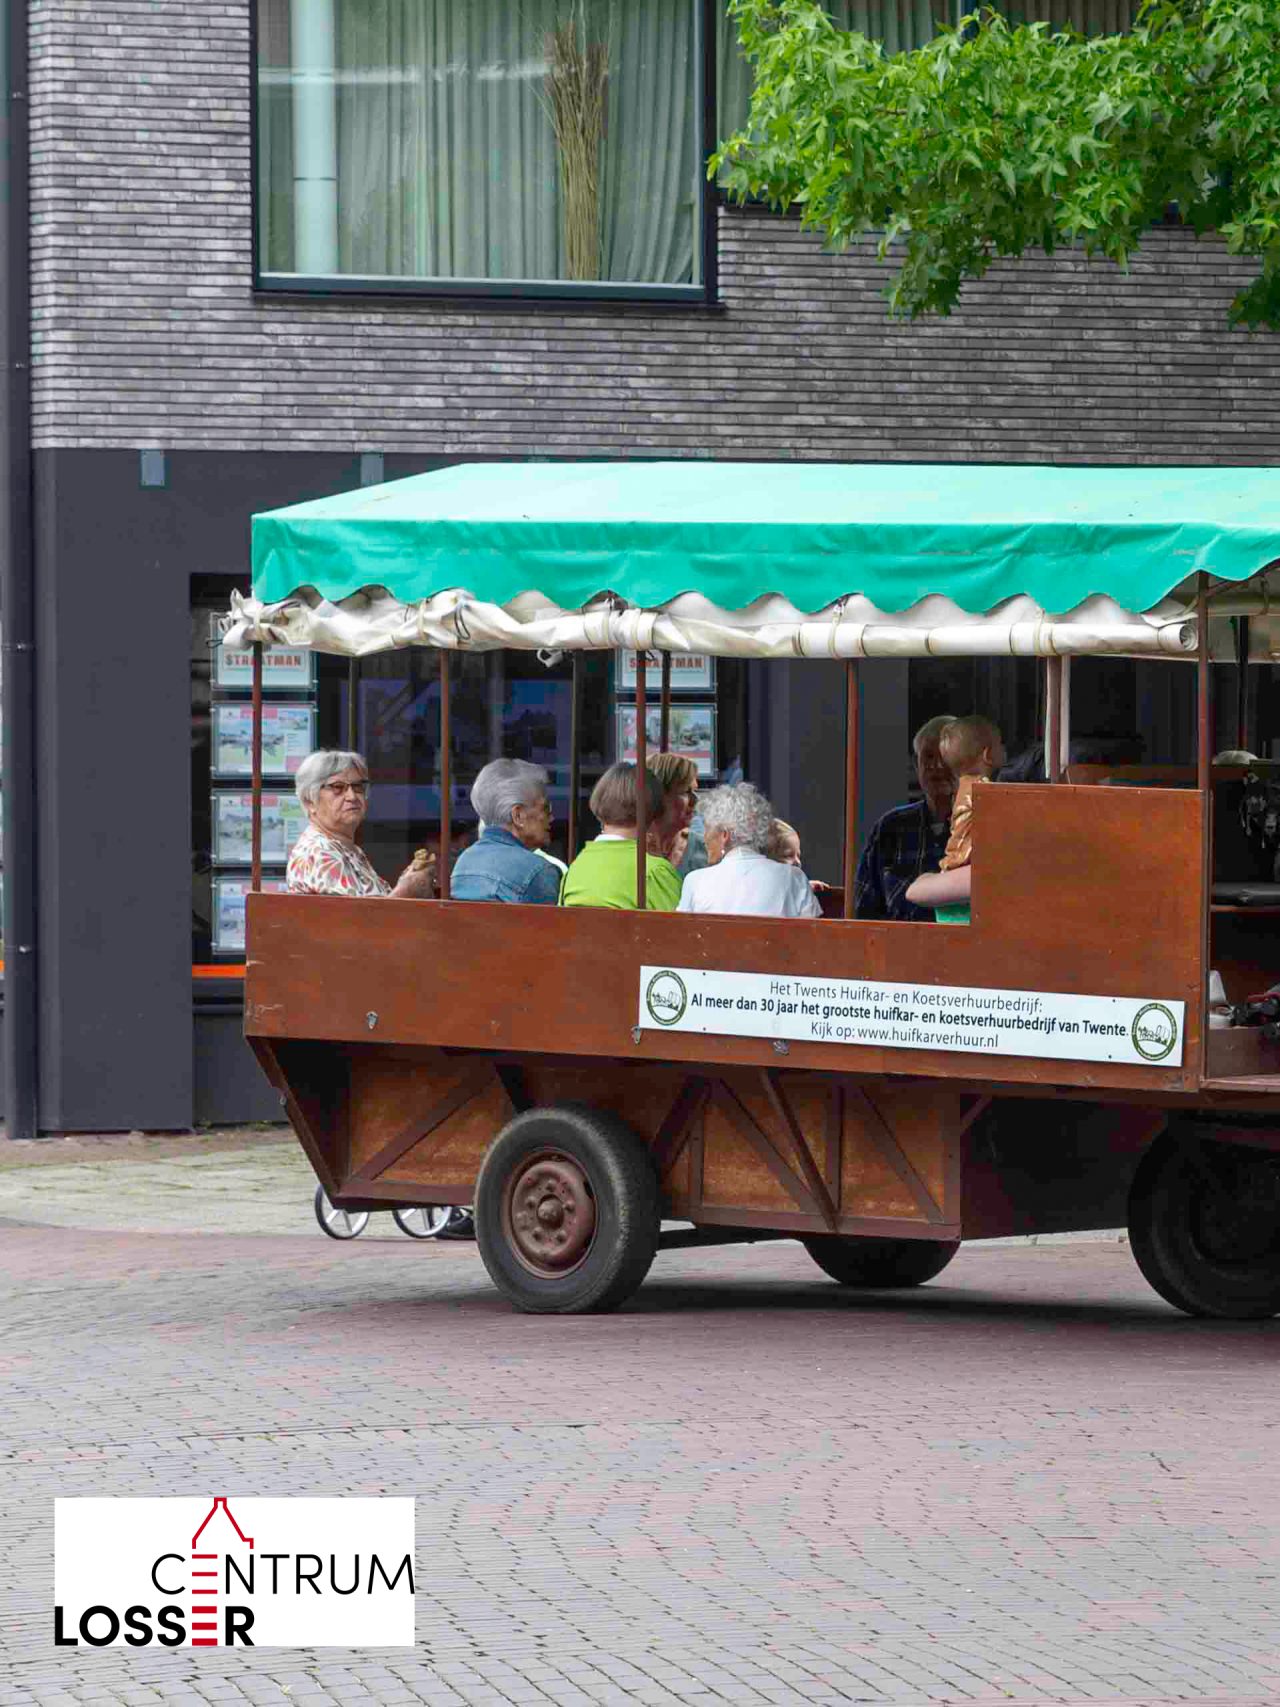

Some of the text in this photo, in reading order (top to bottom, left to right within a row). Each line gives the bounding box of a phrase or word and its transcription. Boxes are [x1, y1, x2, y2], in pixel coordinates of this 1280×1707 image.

[691, 993, 1129, 1037] Al meer dan 30 jaar het grootste huifkar- en koetsverhuurbedrijf van Twente.
[770, 981, 1043, 1016] Het Twents Huifkar- en Koetsverhuurbedrijf:
[811, 1021, 999, 1048] Kijk op: www.huifkarverhuur.nl
